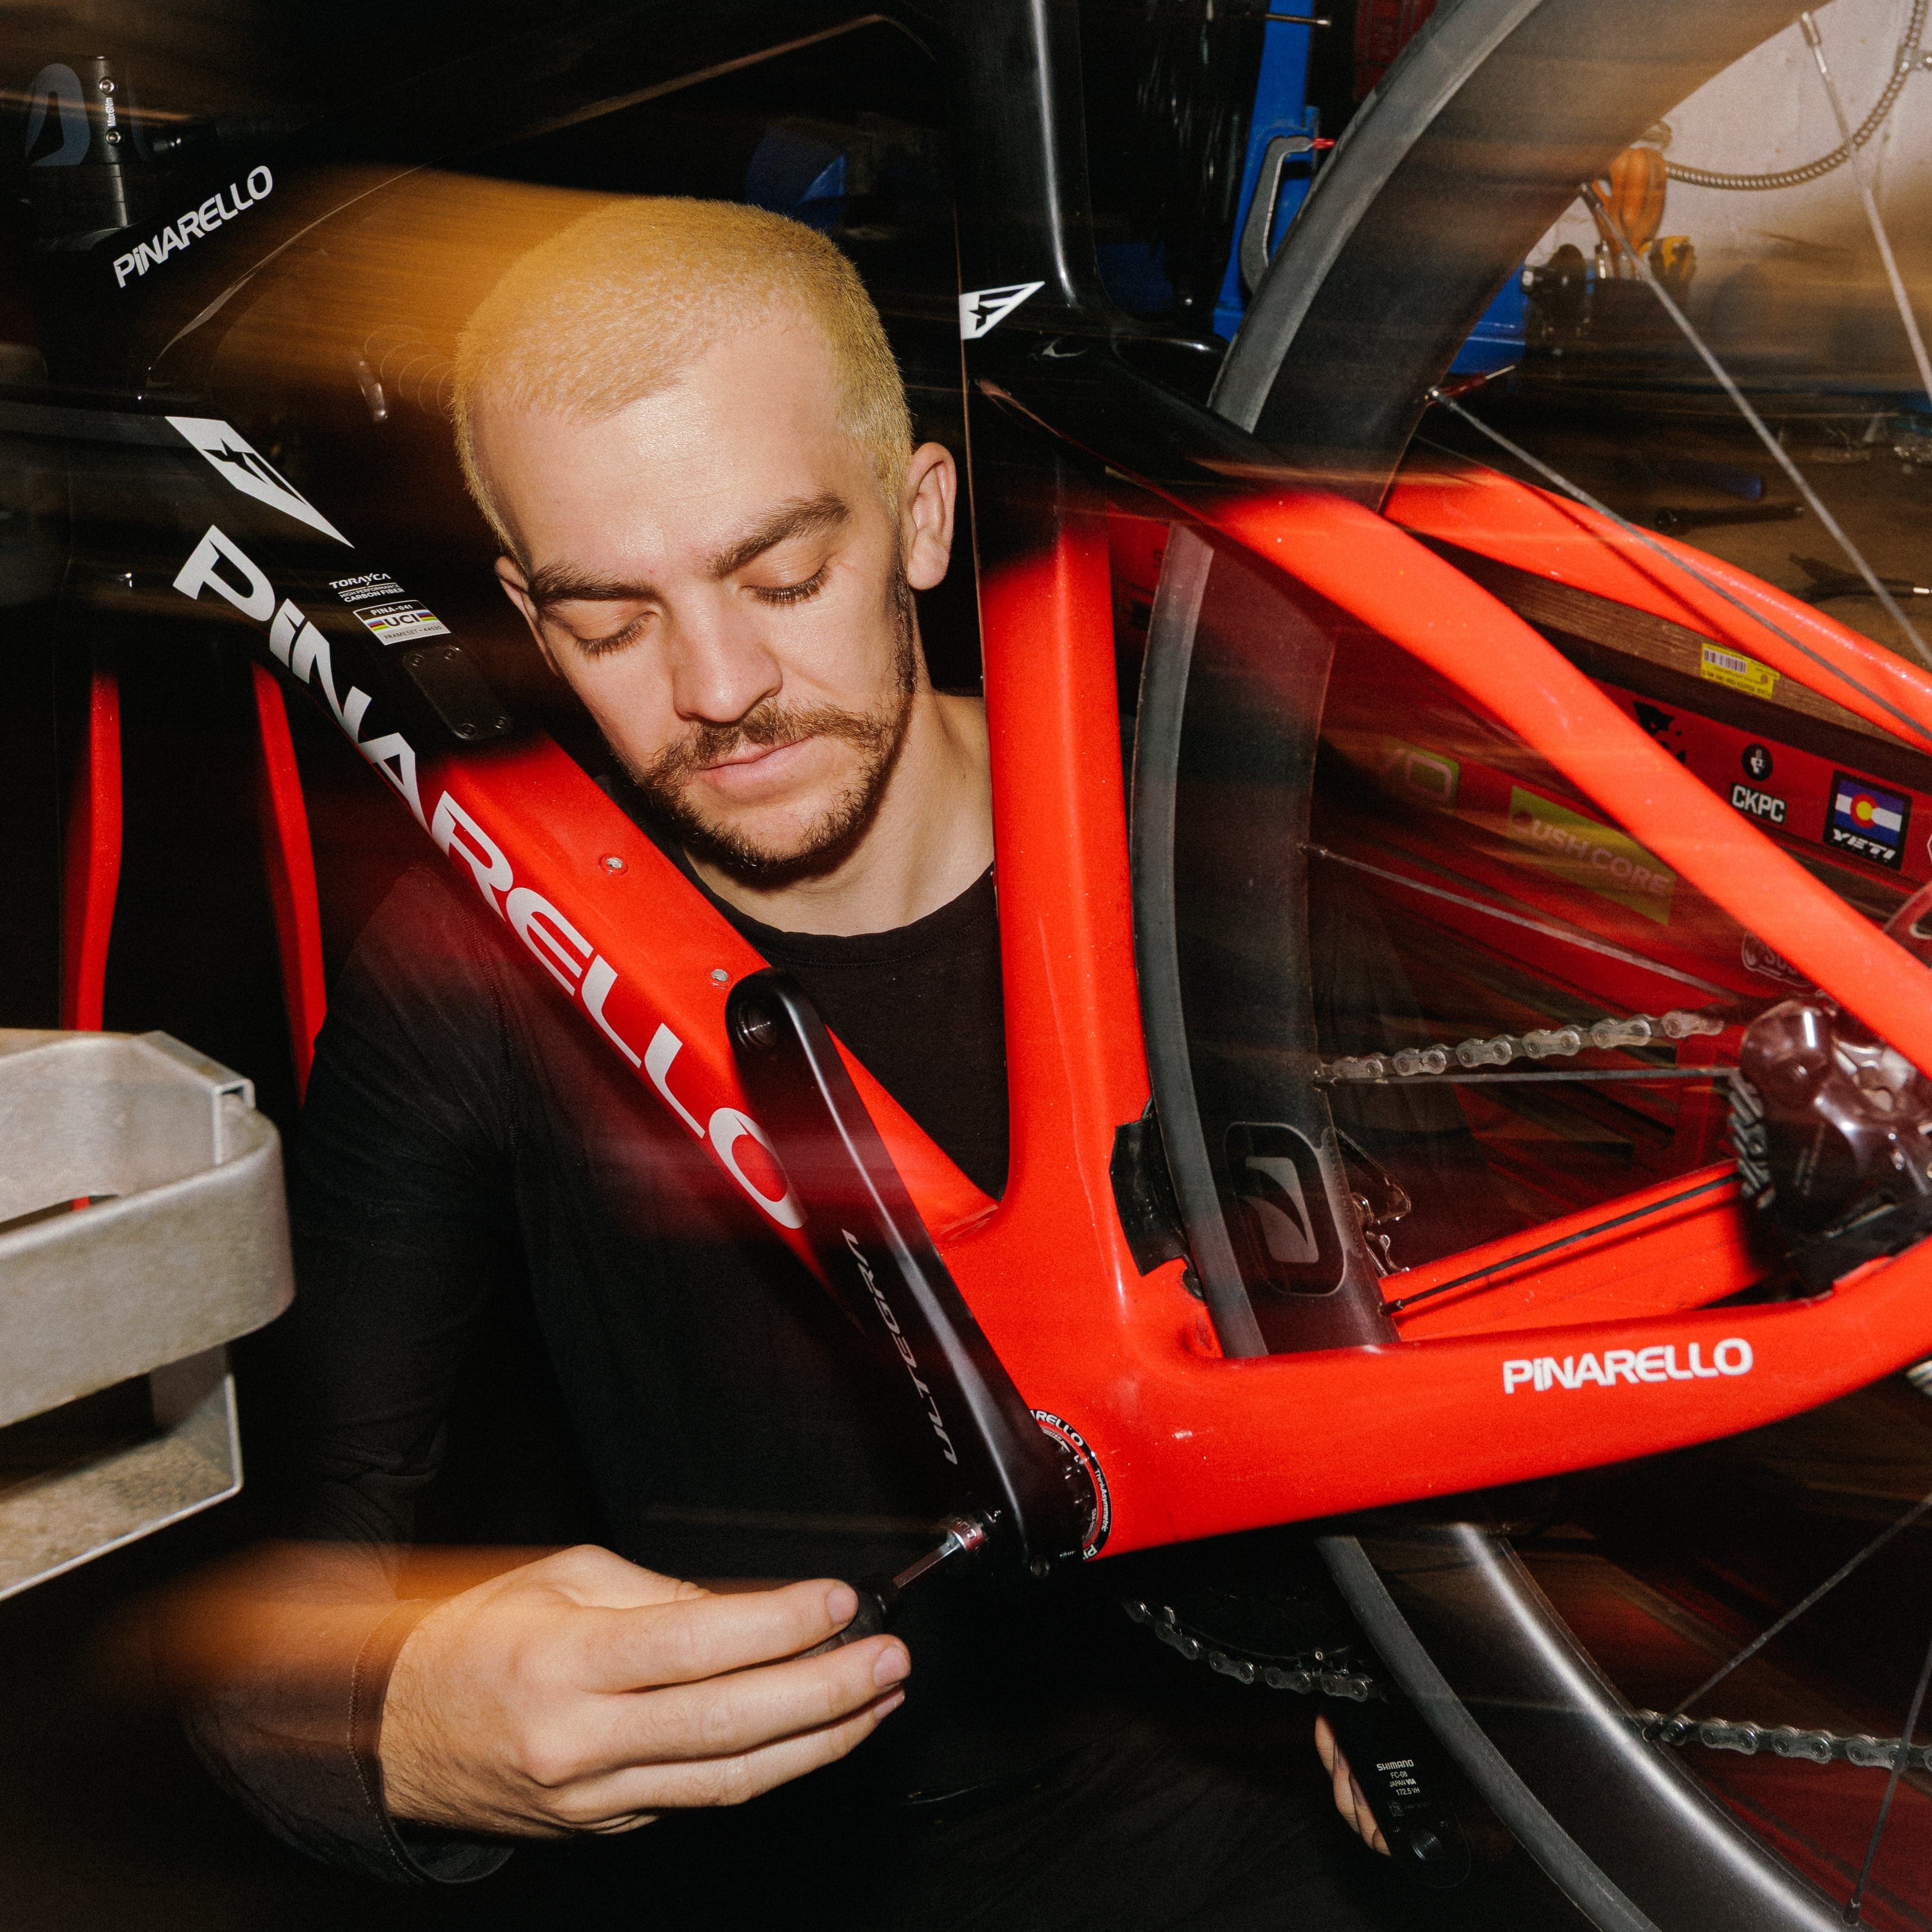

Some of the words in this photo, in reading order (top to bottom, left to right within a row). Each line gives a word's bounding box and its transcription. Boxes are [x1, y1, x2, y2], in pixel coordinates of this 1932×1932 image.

[113, 166, 273, 289] PINARELLO
[329, 573, 391, 589] TORAYCA
[344, 591, 381, 602] CARBON
[382, 587, 405, 595] FIBER
[356, 584, 400, 595] PERFORMANCE
[370, 604, 413, 616] PINA-041
[383, 613, 420, 627] UCI
[384, 629, 418, 640] FRAMESET
[1732, 785, 1786, 823] CKPC
[1833, 828, 1896, 859] YETI
[172, 524, 806, 1229] PINARELLO
[842, 1228, 957, 1465] ULTEGRA
[1503, 1338, 1754, 1394] PINARELLO
[1377, 1759, 1414, 1771] SHIMANO
